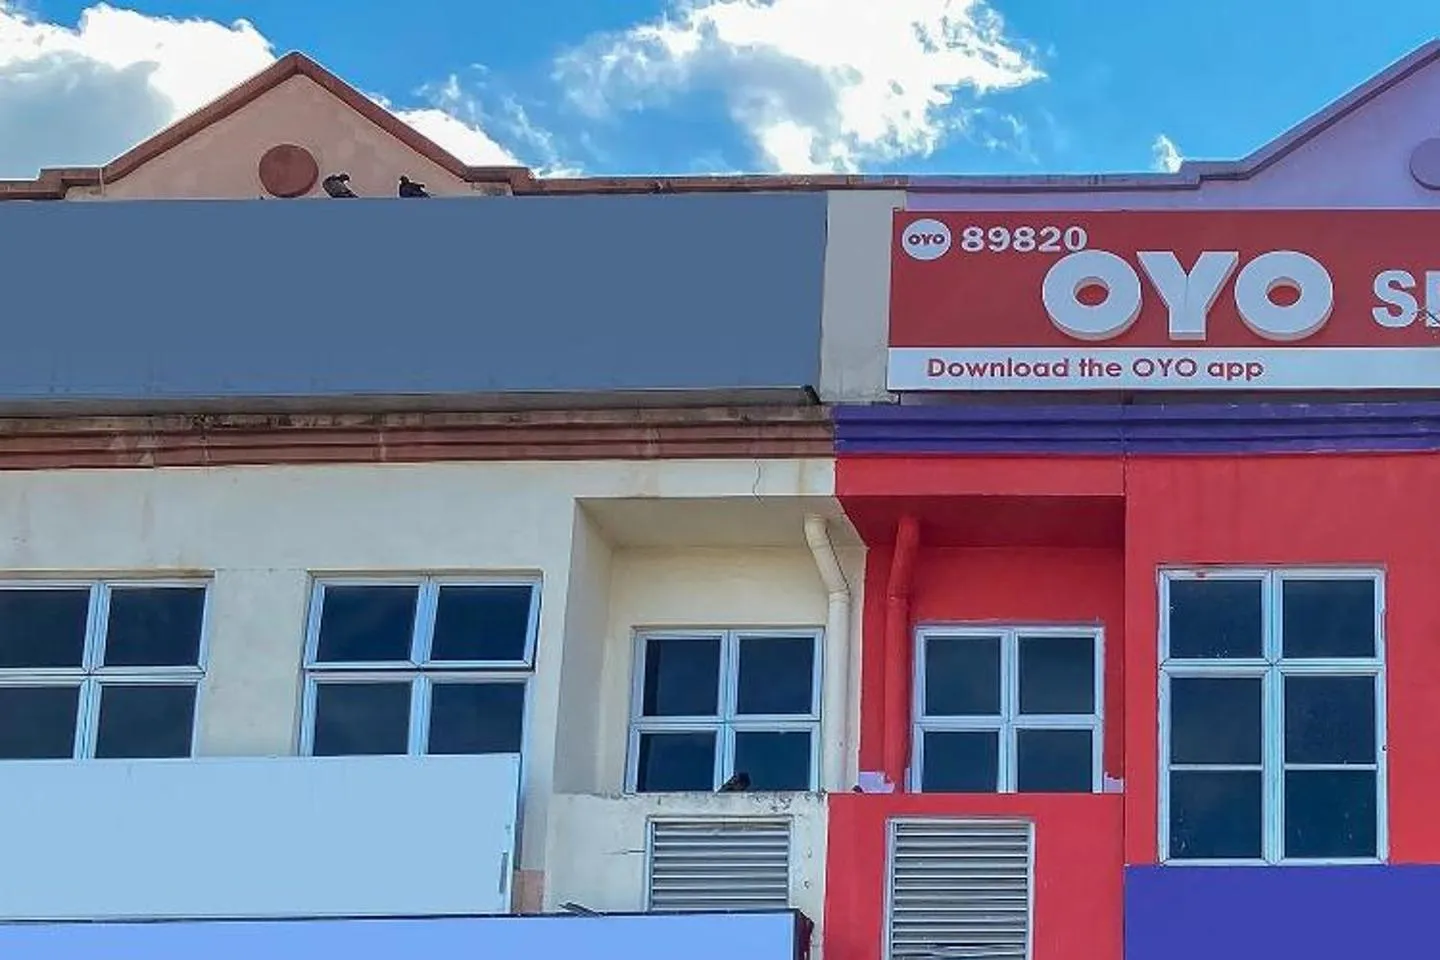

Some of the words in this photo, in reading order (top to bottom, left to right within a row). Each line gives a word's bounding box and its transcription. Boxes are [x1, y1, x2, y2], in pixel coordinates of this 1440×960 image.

[908, 233, 945, 246] OYO
[961, 226, 1087, 252] 89820
[1042, 249, 1333, 341] OYO
[927, 357, 1069, 378] Download
[1079, 358, 1122, 377] the
[1132, 358, 1197, 378] OYO
[1207, 360, 1264, 383] app
